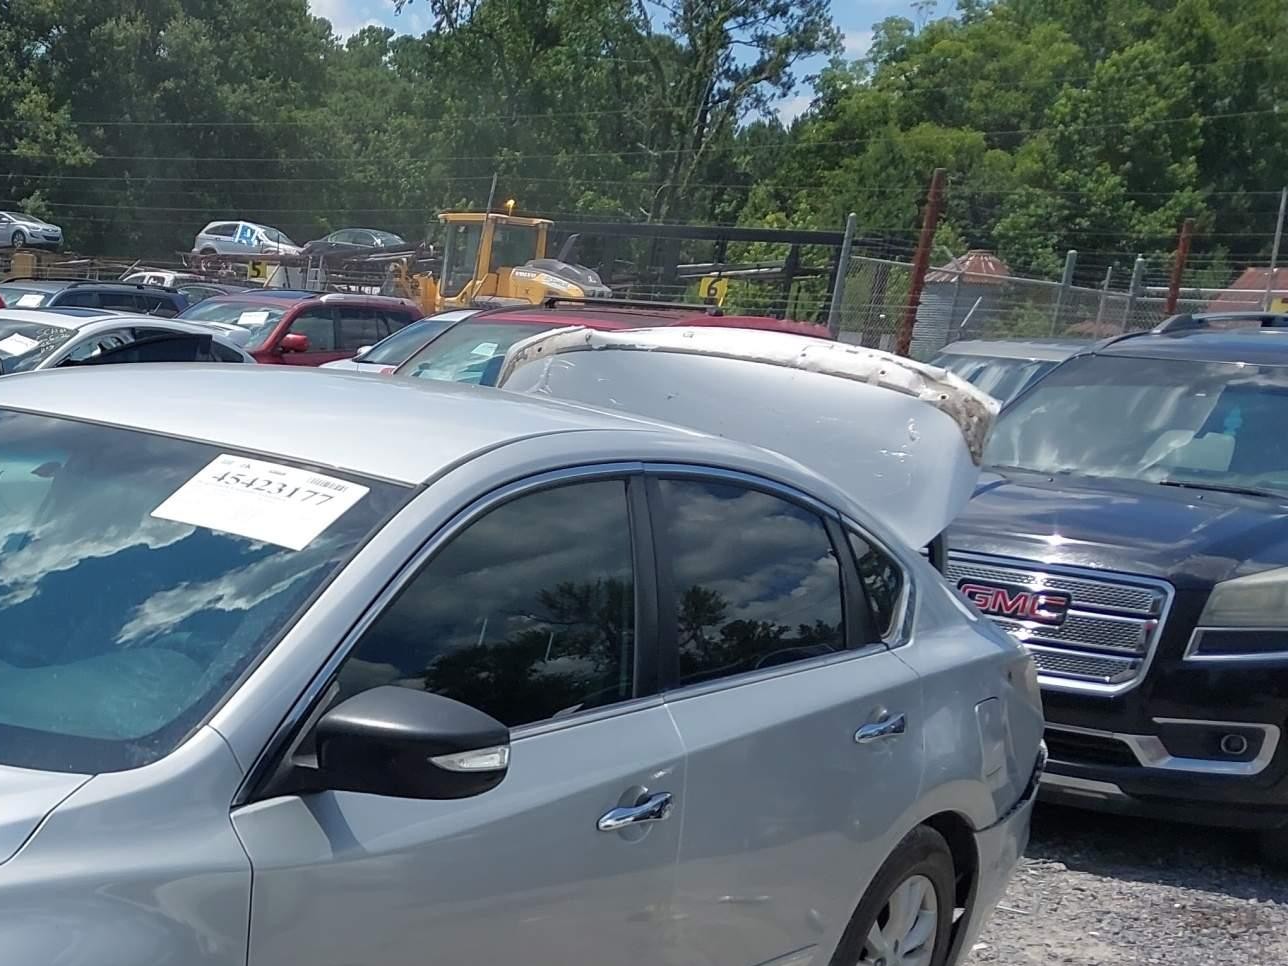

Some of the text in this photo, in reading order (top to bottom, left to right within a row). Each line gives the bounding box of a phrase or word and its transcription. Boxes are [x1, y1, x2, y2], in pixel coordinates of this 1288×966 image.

[251, 261, 262, 279] 5
[707, 278, 722, 297] 6
[211, 471, 334, 506] 45423177
[961, 583, 1066, 620] GMC
